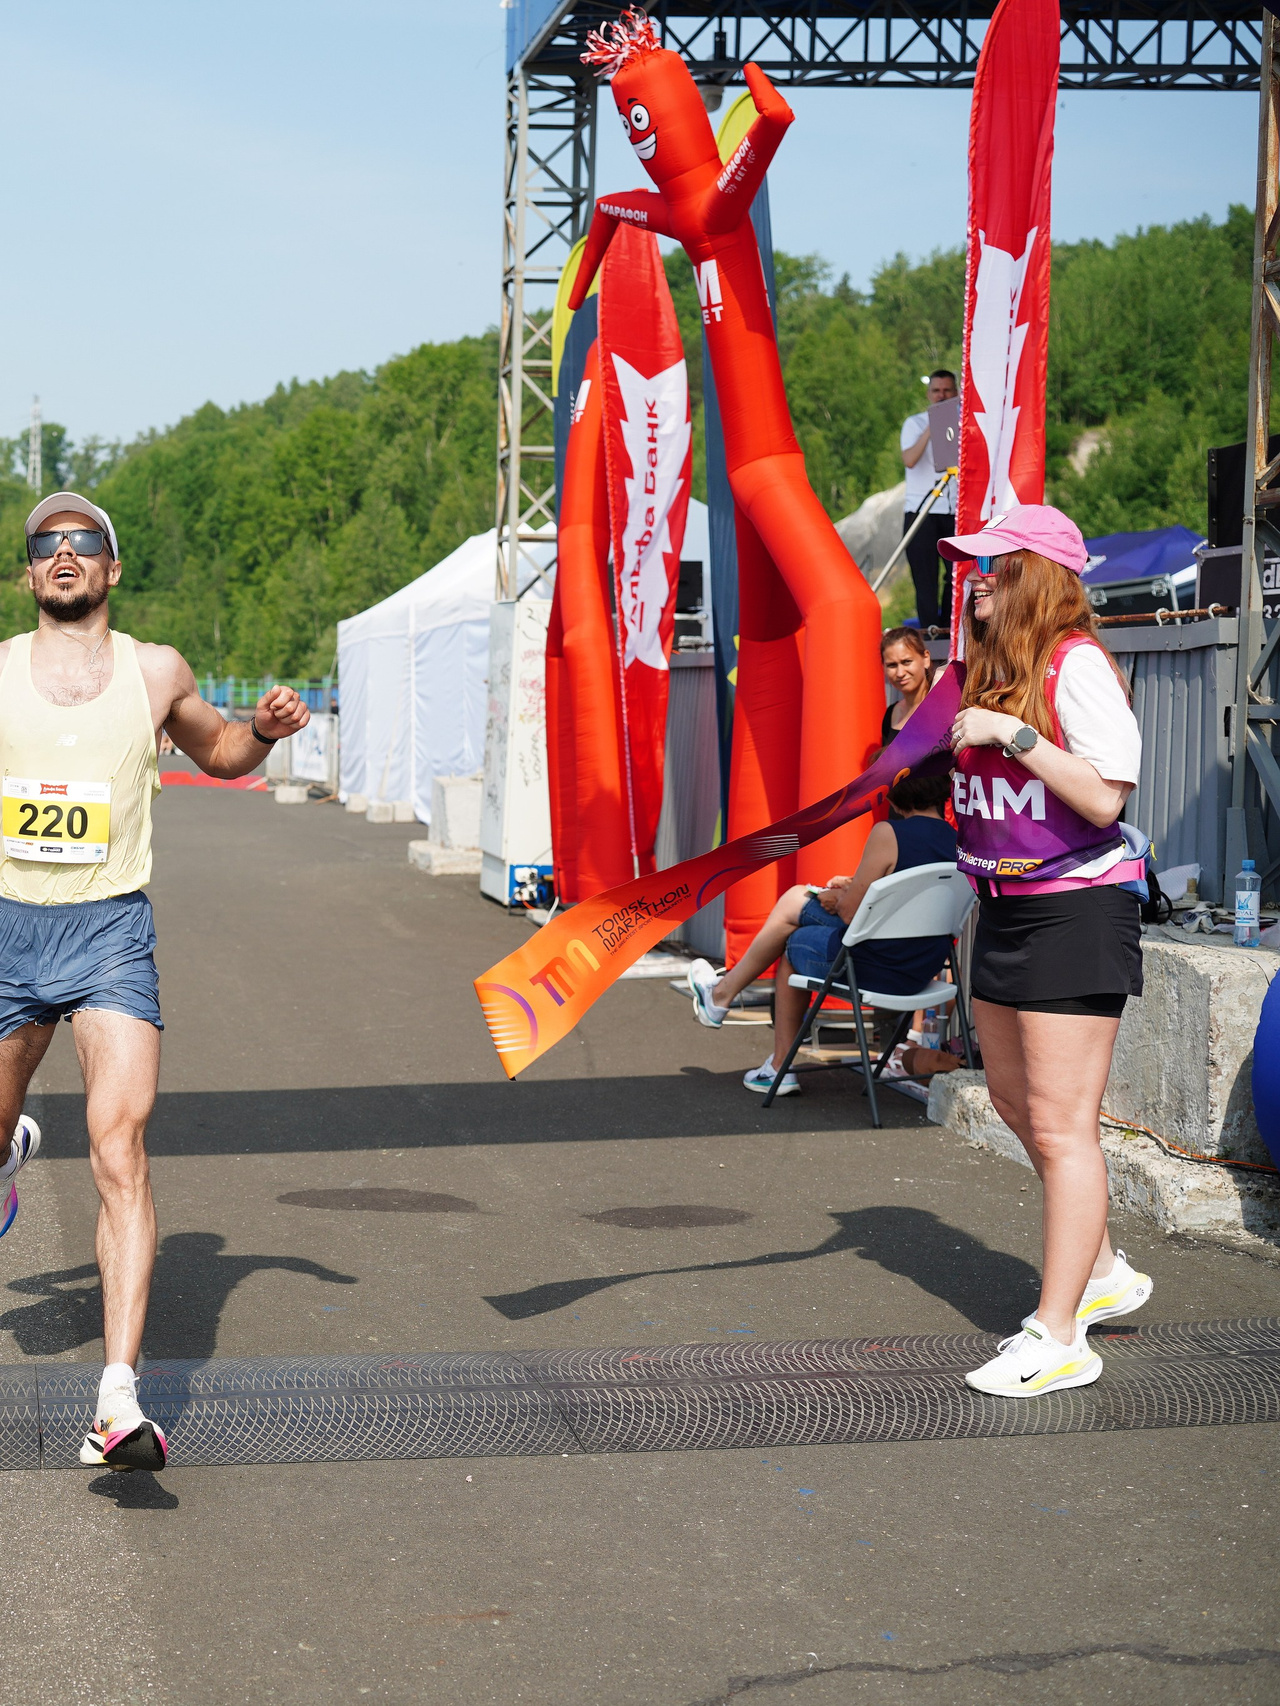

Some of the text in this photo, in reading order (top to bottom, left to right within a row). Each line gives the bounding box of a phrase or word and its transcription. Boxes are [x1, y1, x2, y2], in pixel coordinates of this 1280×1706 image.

[717, 136, 751, 191] МАРАФОН
[600, 203, 648, 222] МАРАФОН
[702, 305, 724, 325] ЕТ
[952, 772, 1046, 820] EAM
[19, 803, 88, 839] 220
[999, 861, 1039, 873] PRO
[592, 896, 648, 939] TOMSK
[602, 884, 690, 951] MARATHON
[638, 917, 654, 932] SPORT
[654, 897, 684, 919] COMMUNITY
